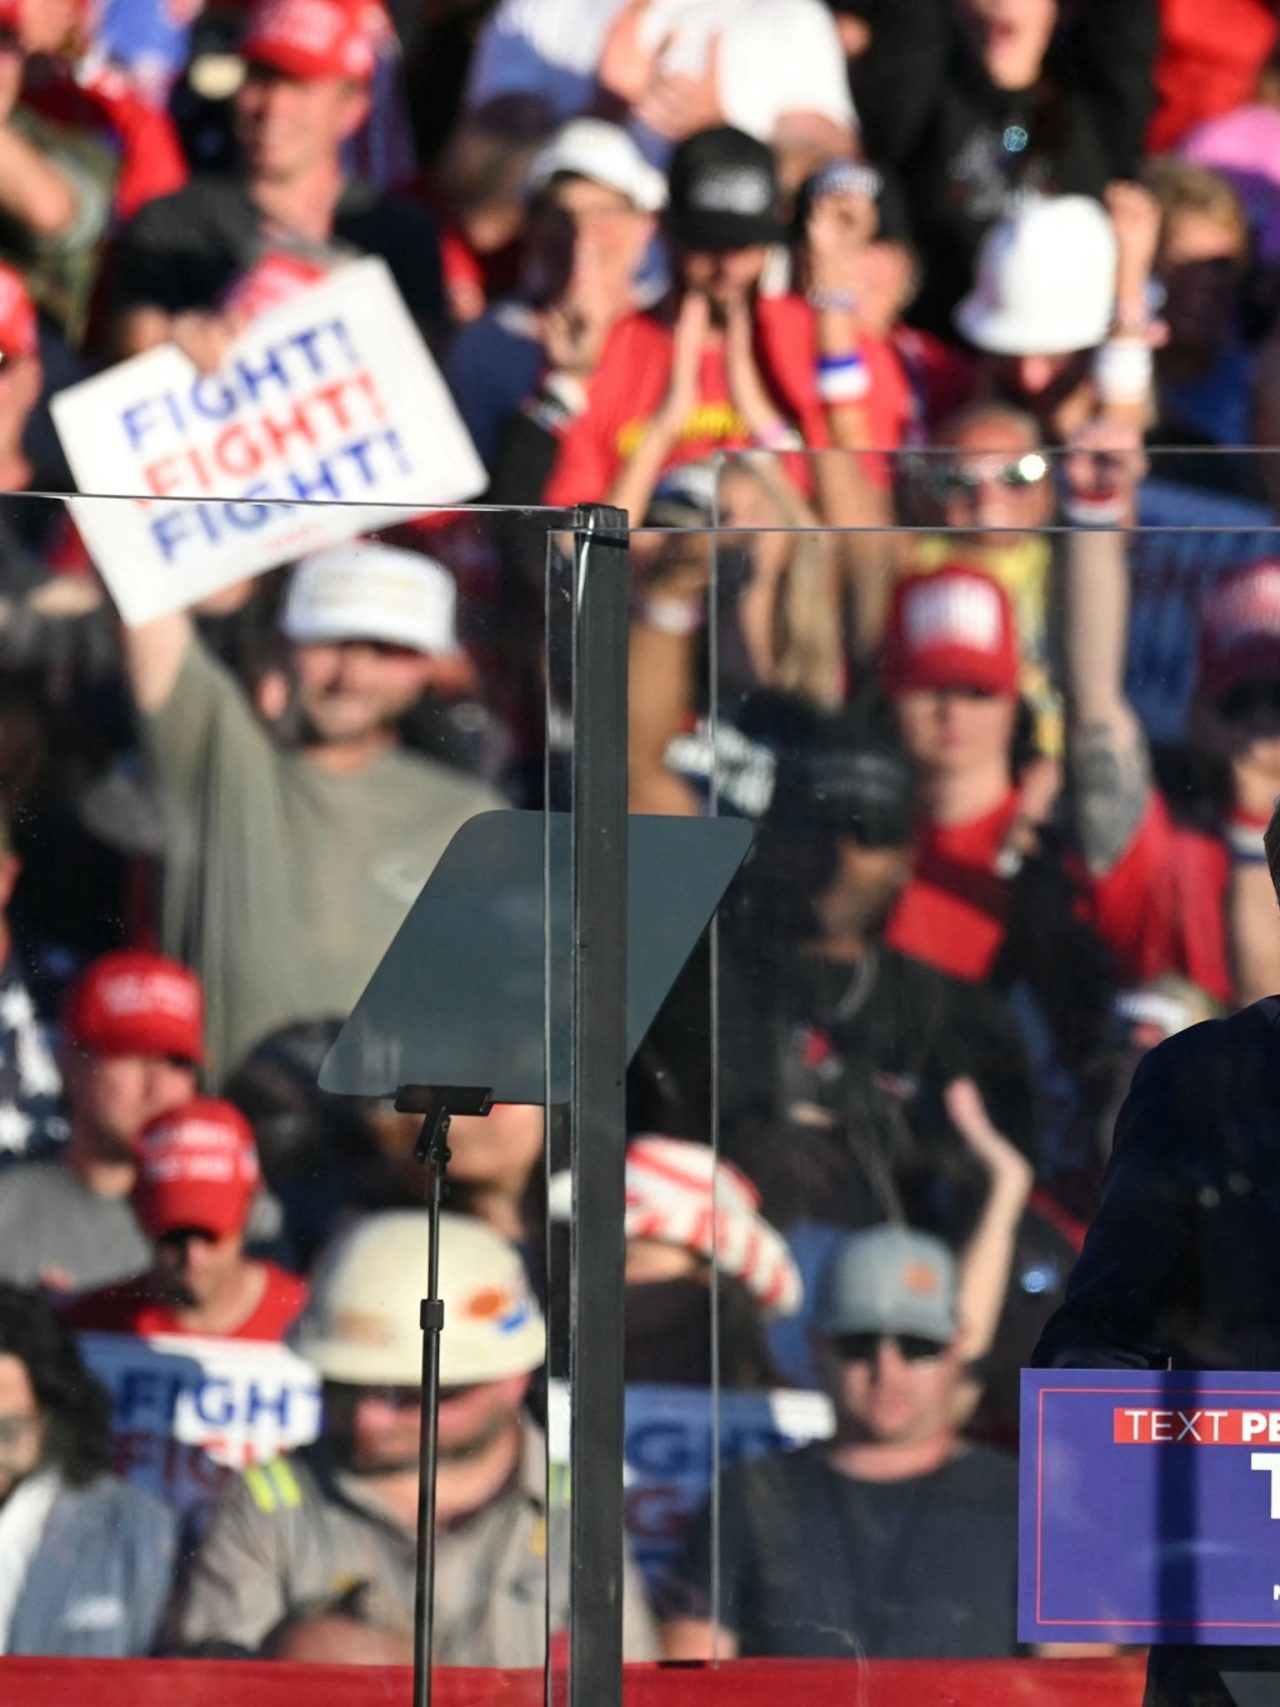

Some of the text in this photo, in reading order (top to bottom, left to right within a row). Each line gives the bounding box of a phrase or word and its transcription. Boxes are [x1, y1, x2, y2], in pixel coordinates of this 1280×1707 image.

[119, 316, 361, 452] FIGHT!
[139, 369, 390, 504] FIGHT!
[1124, 1410, 1228, 1441] TEXT
